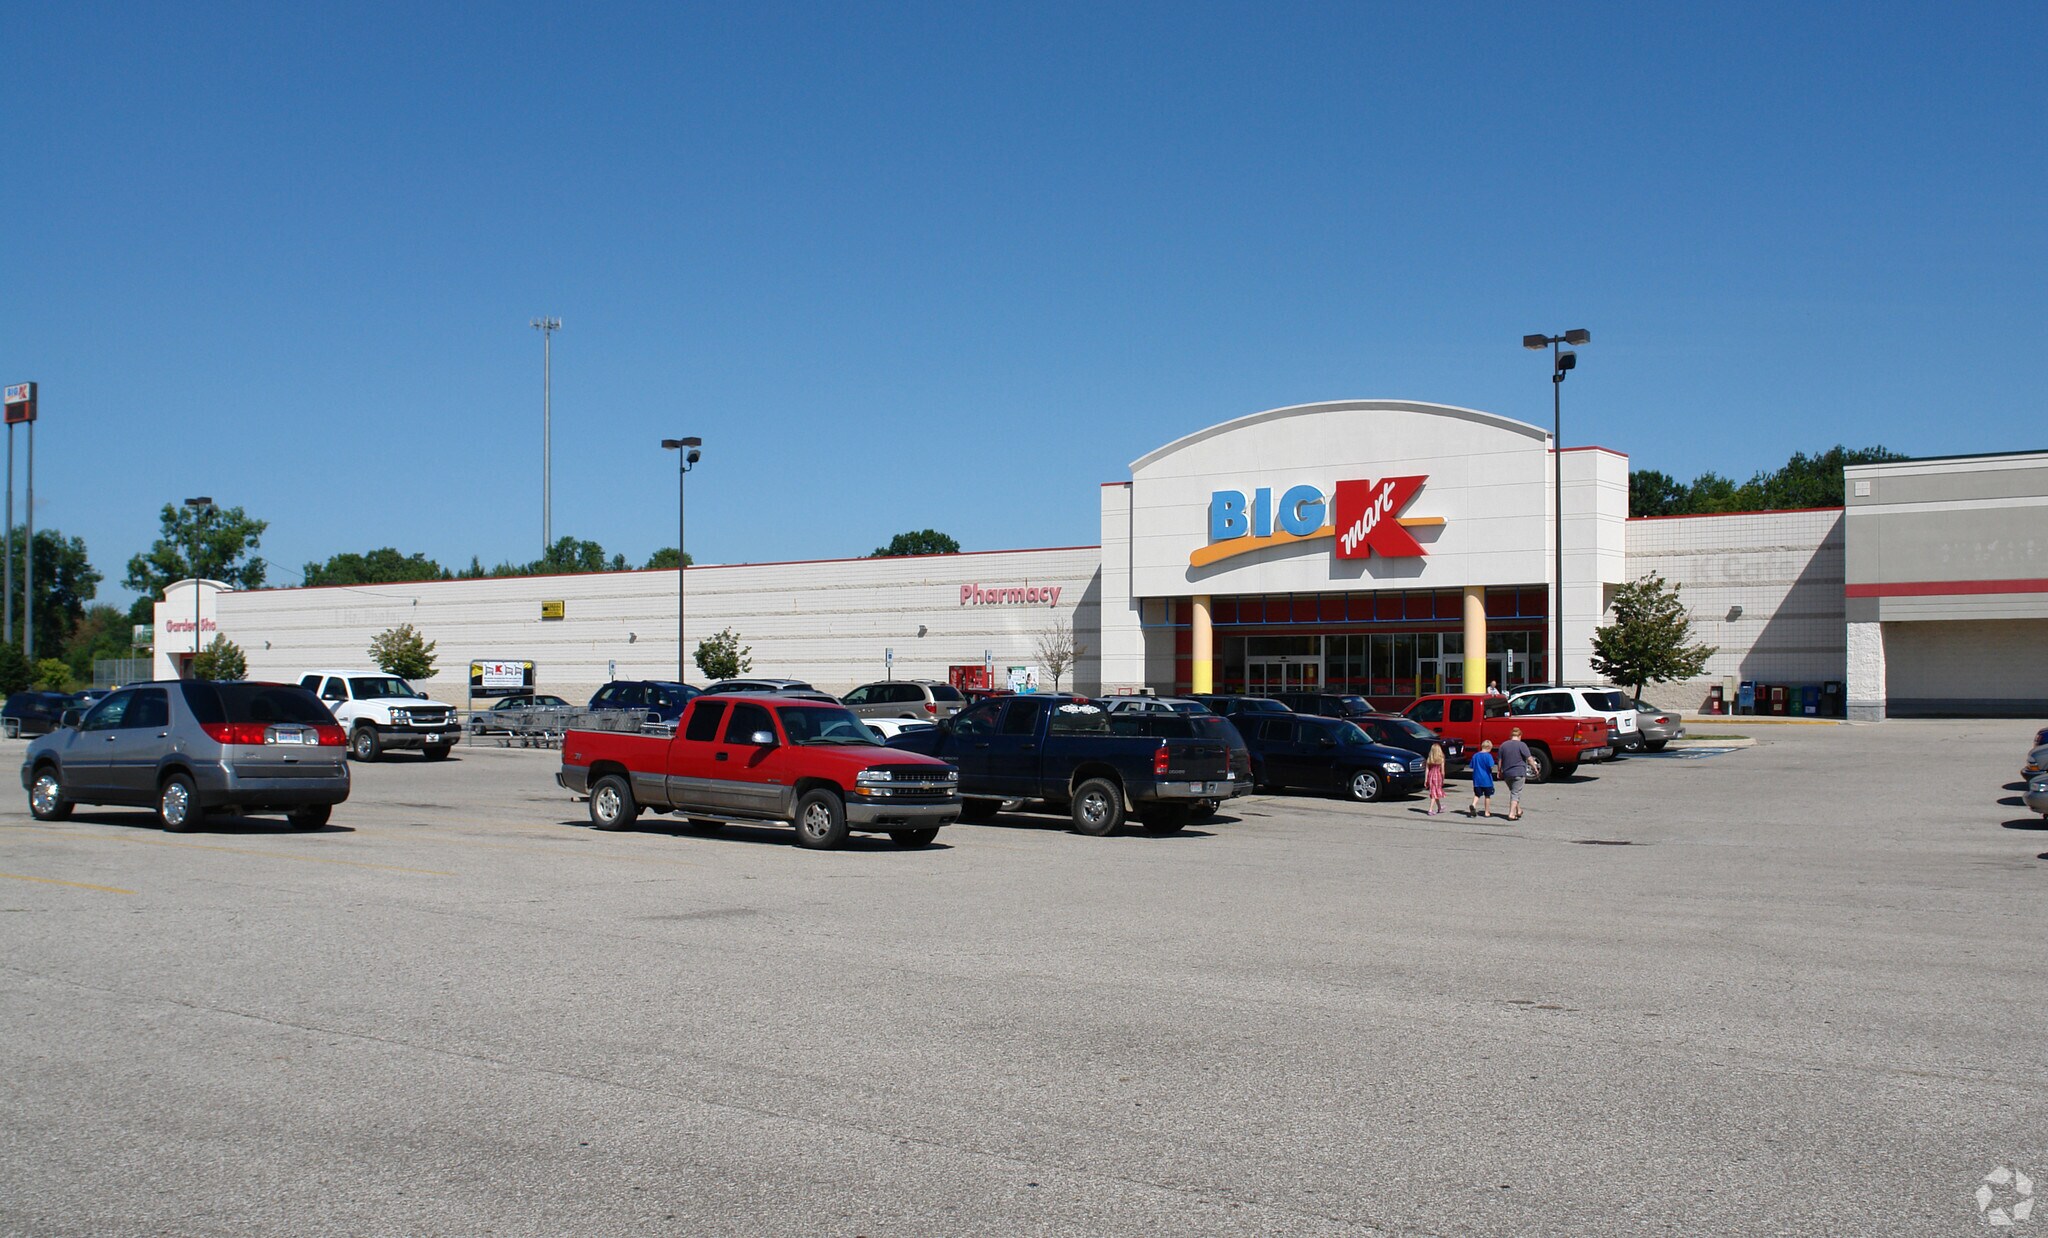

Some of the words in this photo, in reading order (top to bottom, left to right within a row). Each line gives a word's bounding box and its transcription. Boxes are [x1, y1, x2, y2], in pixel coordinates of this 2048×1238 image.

[1211, 484, 1326, 539] BIG
[1336, 475, 1429, 559] K
[1340, 481, 1396, 555] mart
[960, 583, 1062, 608] Pharmacy
